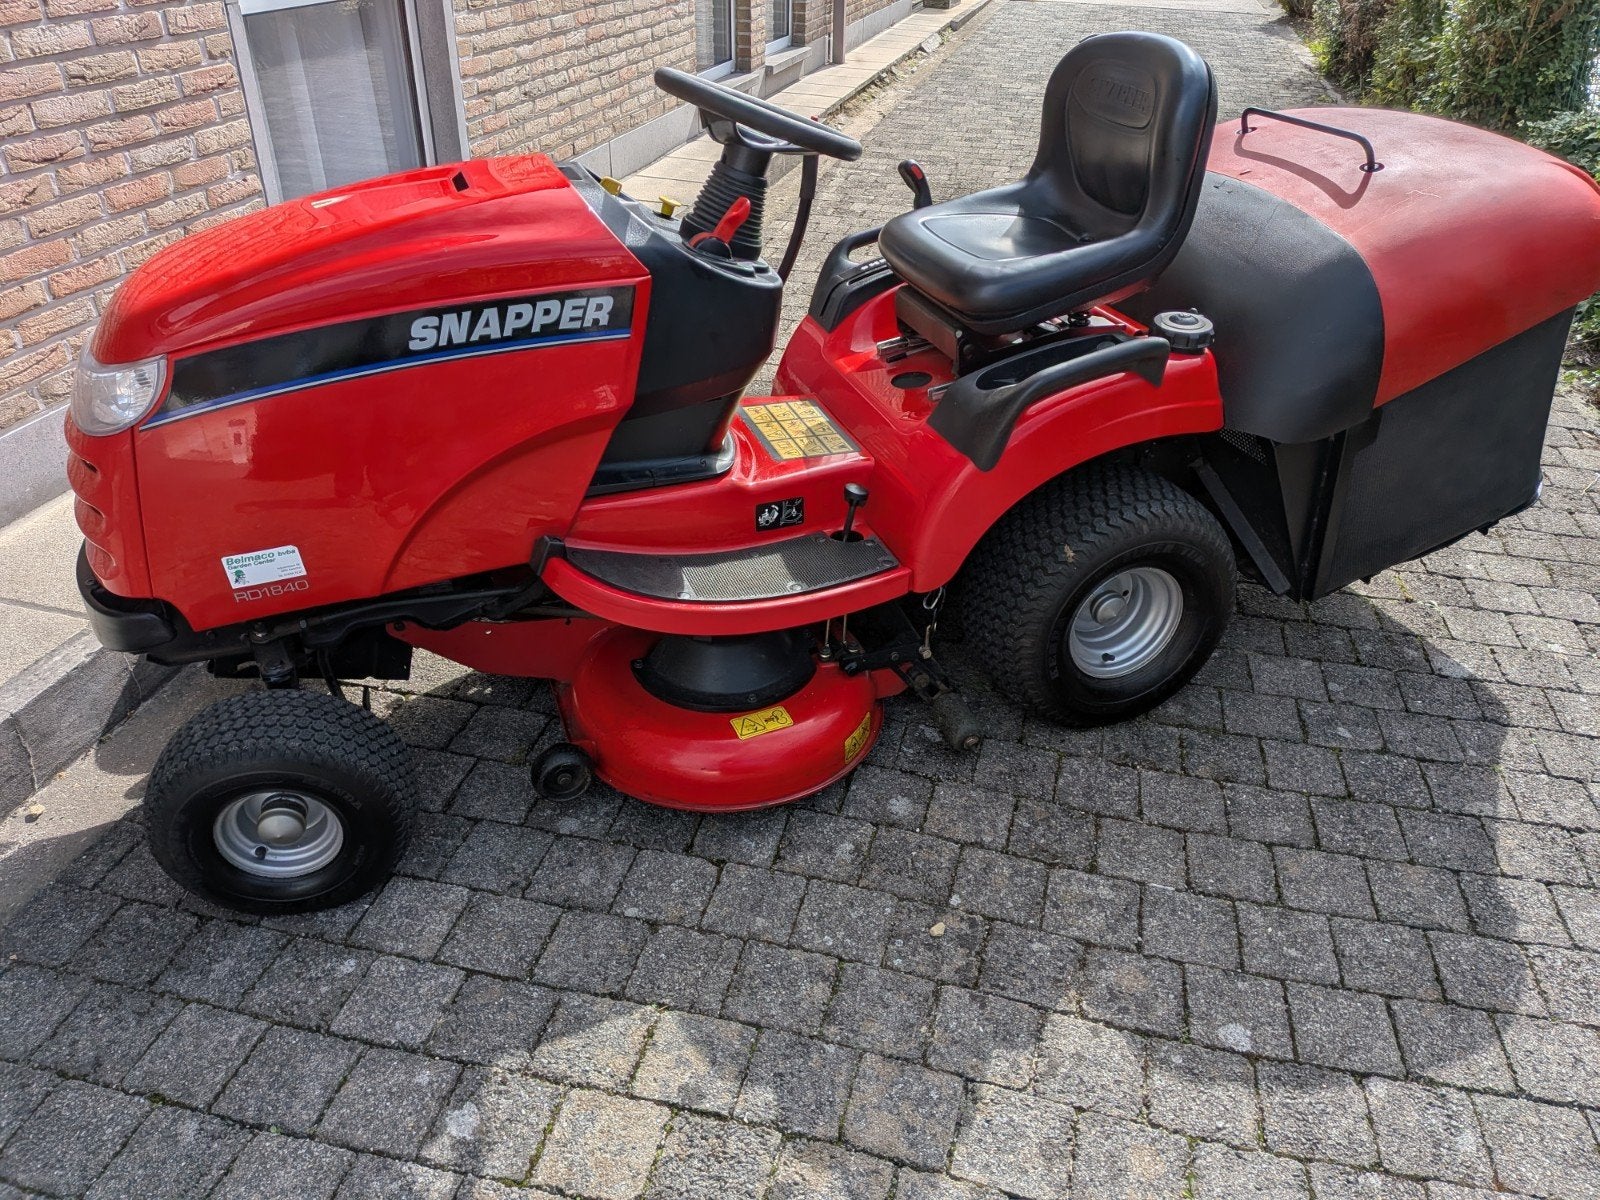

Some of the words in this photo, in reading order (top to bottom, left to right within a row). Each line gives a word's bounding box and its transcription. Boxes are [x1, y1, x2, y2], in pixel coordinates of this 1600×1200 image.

[408, 295, 614, 351] SNAPPER
[226, 552, 275, 566] Belmaco
[277, 549, 296, 557] bvba
[227, 562, 252, 570] Garden
[253, 558, 276, 566] Center
[234, 580, 309, 603] RD1840
